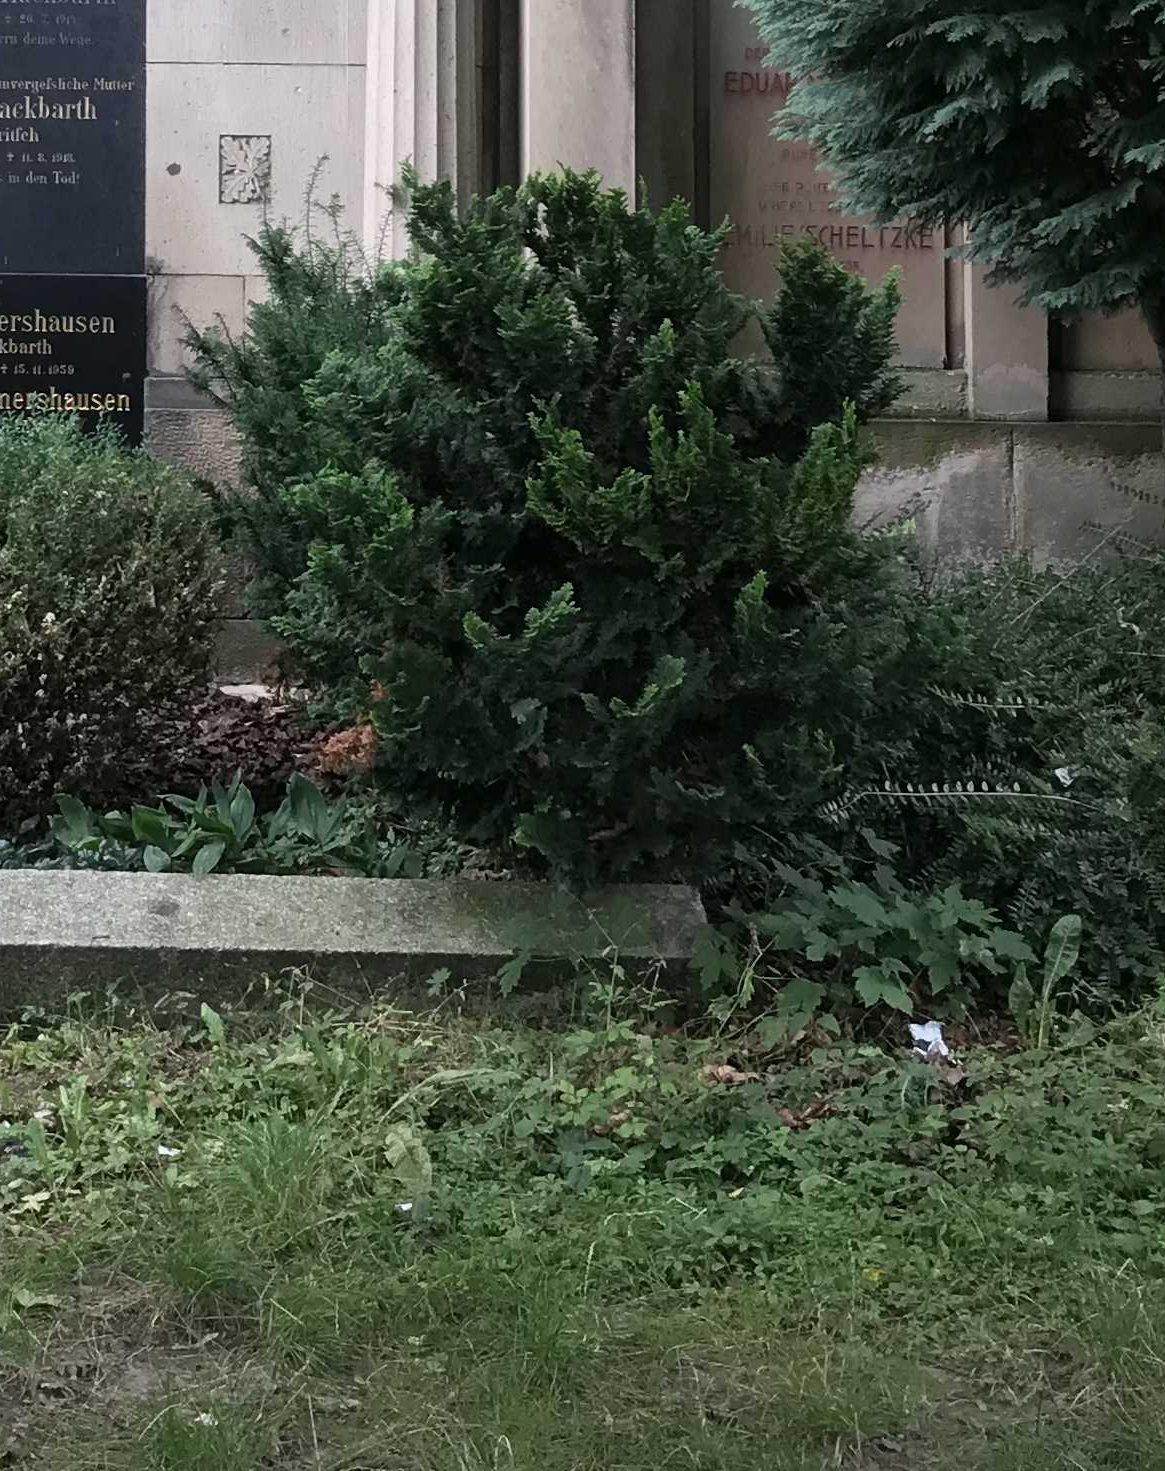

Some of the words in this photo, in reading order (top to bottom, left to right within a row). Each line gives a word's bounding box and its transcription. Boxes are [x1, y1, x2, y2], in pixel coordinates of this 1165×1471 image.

[94, 77, 135, 91] Mutter
[9, 171, 21, 184] in
[25, 170, 47, 184] den
